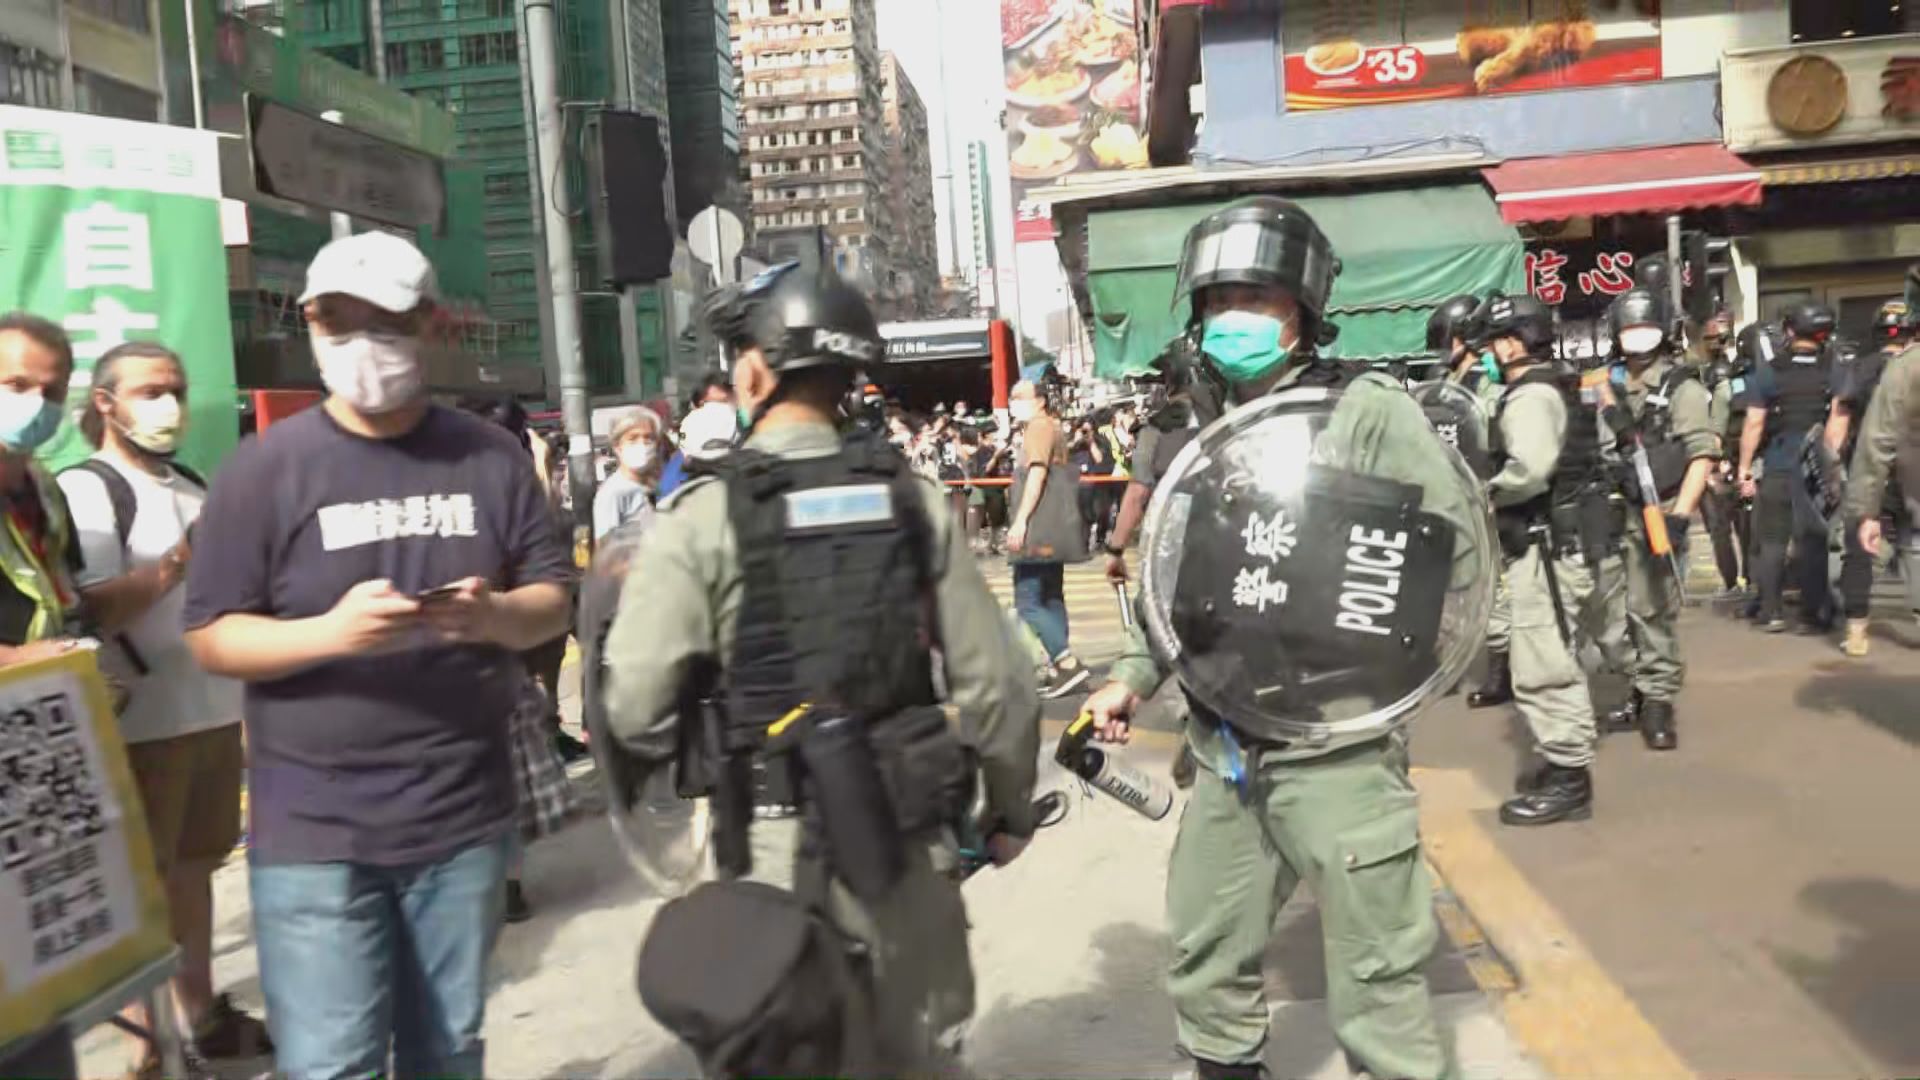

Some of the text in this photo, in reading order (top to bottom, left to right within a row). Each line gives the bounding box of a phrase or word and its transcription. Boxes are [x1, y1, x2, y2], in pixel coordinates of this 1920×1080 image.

[1525, 250, 1692, 305] 信心
[1232, 510, 1297, 615] 警察
[1335, 524, 1408, 635] POLICE
